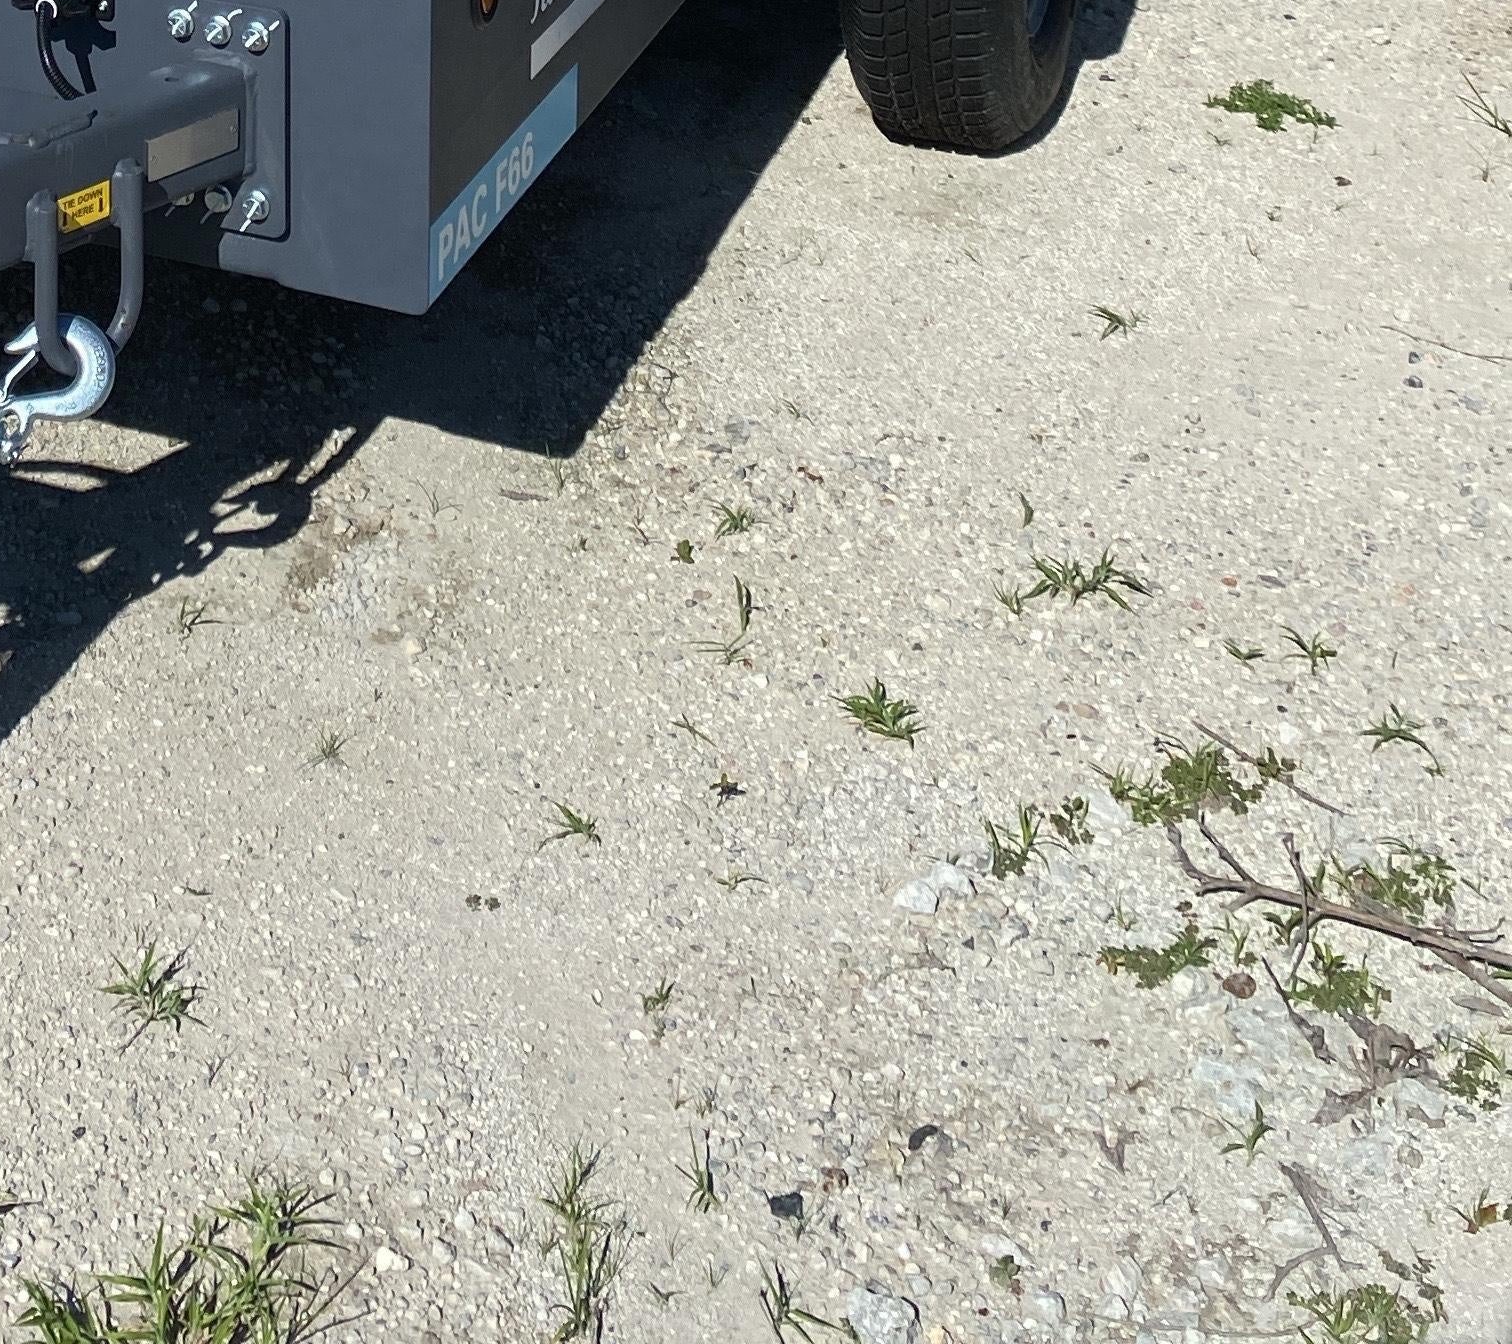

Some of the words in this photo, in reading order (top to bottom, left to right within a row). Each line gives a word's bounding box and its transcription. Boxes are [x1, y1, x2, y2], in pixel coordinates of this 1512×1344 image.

[77, 187, 103, 206] DOWN
[438, 183, 488, 281] PAC
[495, 131, 534, 214] F66
